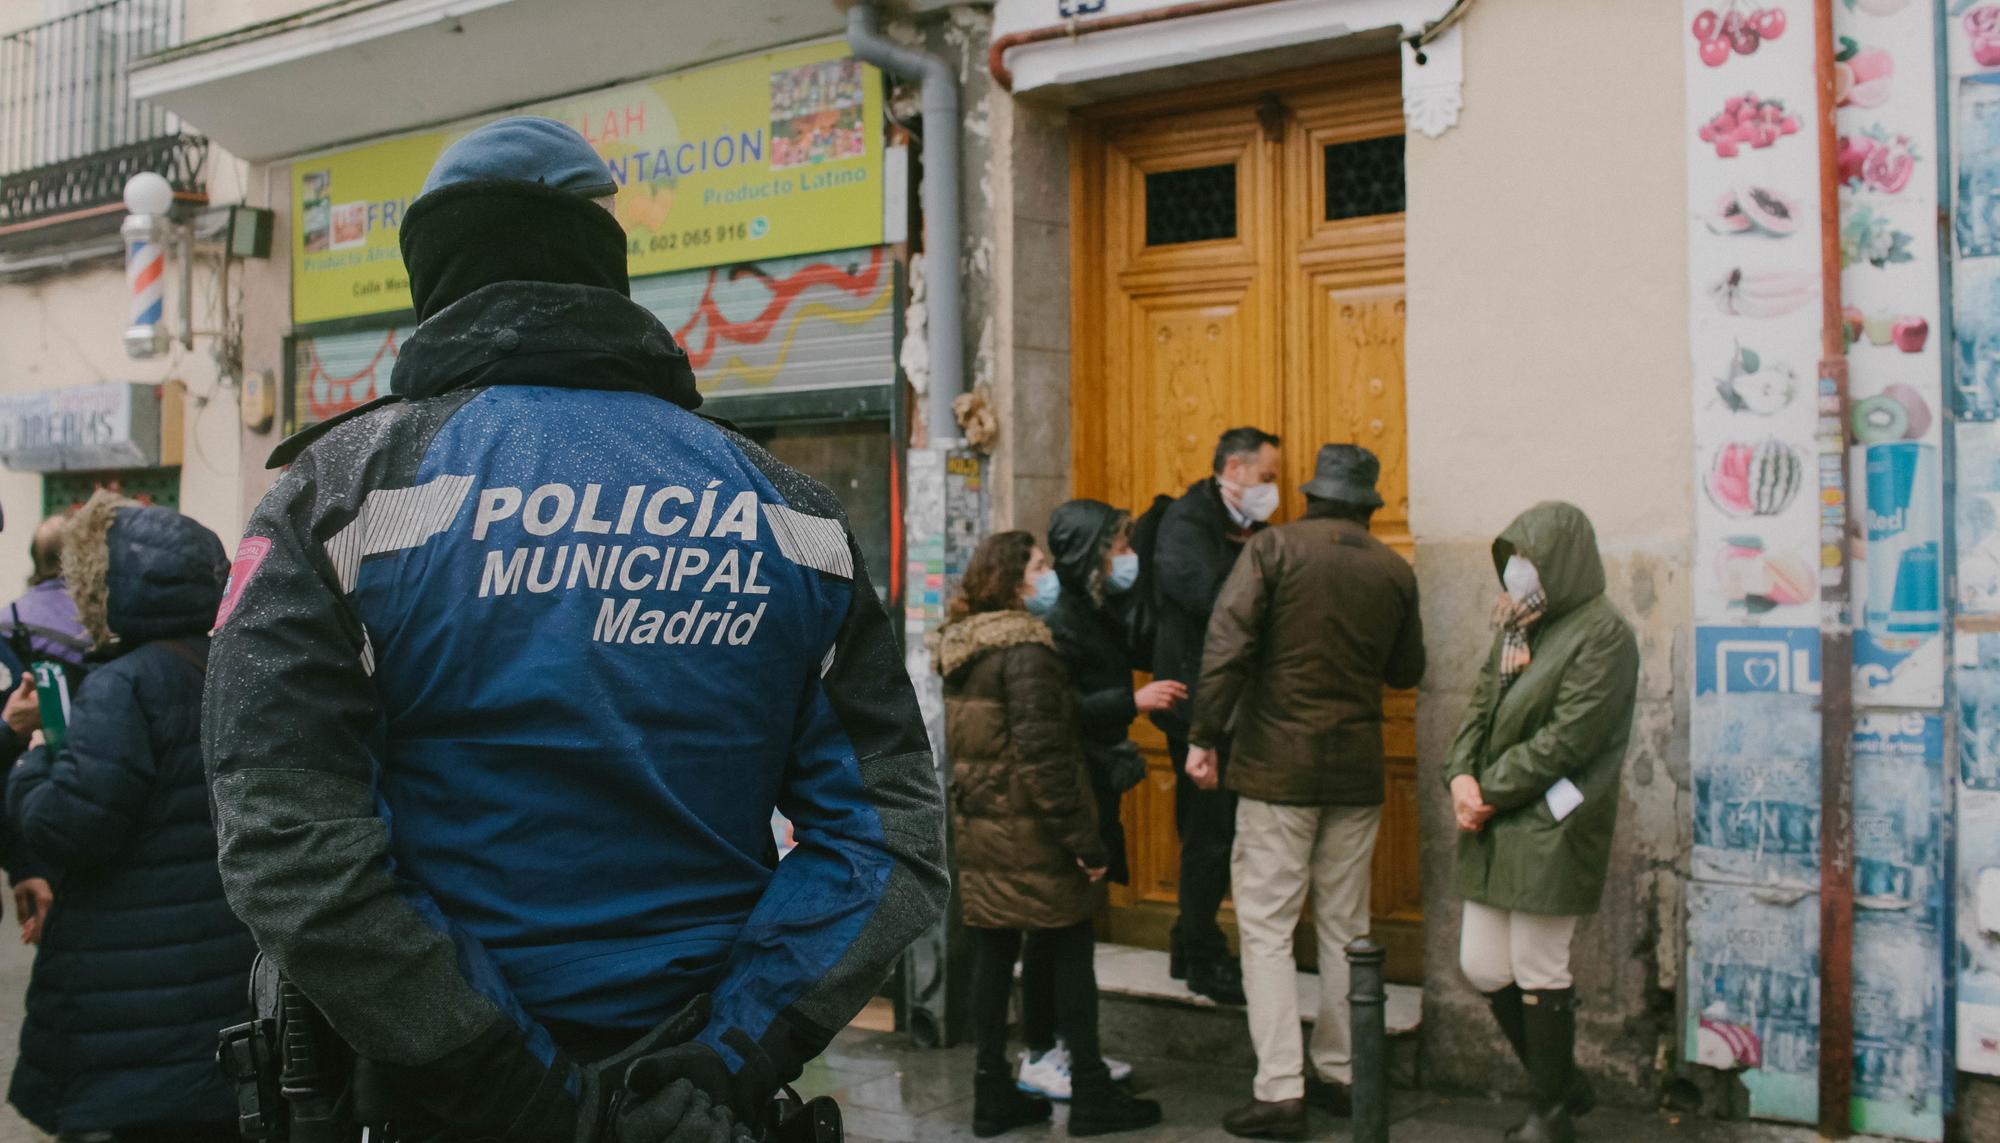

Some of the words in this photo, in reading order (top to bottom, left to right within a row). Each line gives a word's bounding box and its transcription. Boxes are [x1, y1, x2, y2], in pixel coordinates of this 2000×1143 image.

[703, 179, 793, 207] Producto
[800, 167, 867, 192] Latino
[650, 233, 677, 252] 602
[717, 223, 747, 243] 916
[472, 480, 758, 541] POLICÍA
[478, 543, 771, 598] MUNICIPAL
[592, 597, 767, 647] Madrid
